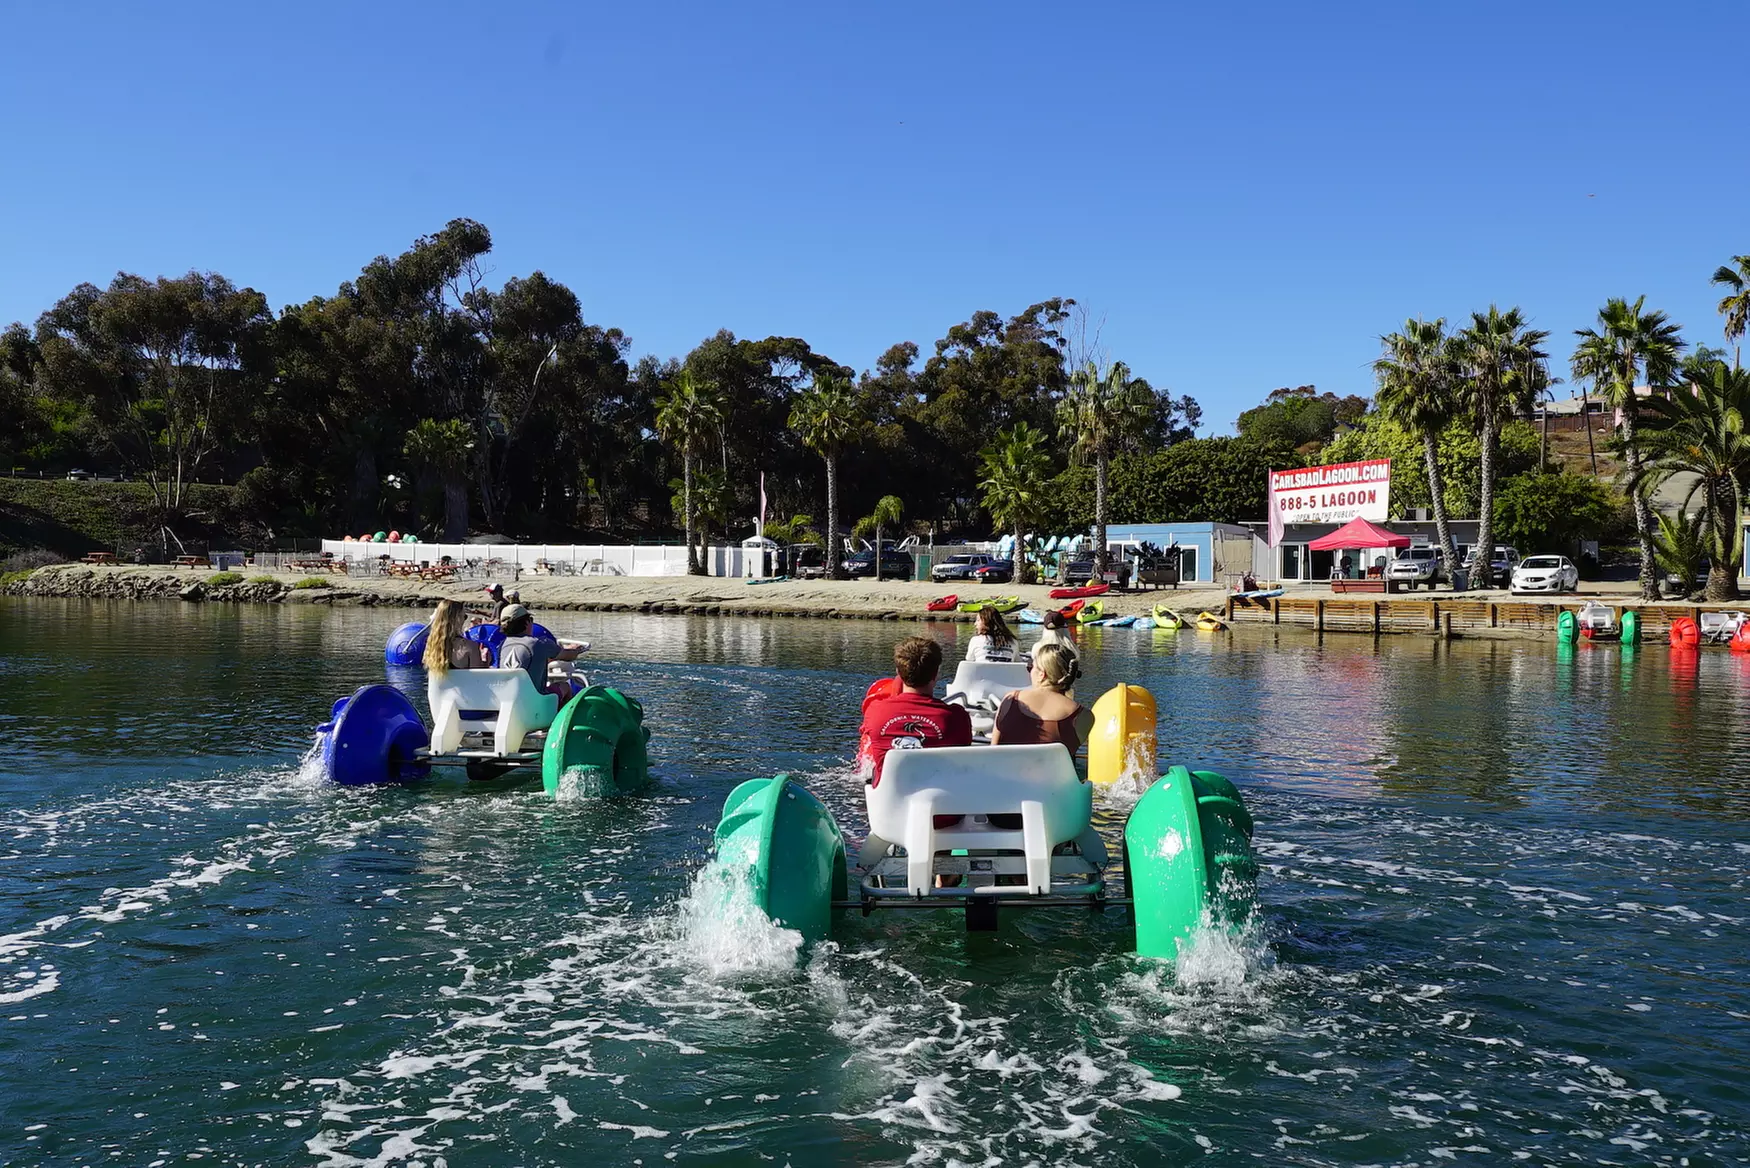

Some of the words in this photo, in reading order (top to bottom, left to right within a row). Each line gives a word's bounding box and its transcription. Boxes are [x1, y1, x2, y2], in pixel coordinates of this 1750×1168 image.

[1272, 463, 1388, 490] CARLSBADLAGOON.COM
[1280, 495, 1316, 511] 888-5
[1321, 489, 1376, 508] LAGOON
[1311, 512, 1320, 520] TO
[1321, 511, 1332, 520] THE
[880, 715, 907, 736] CALIFORNIA
